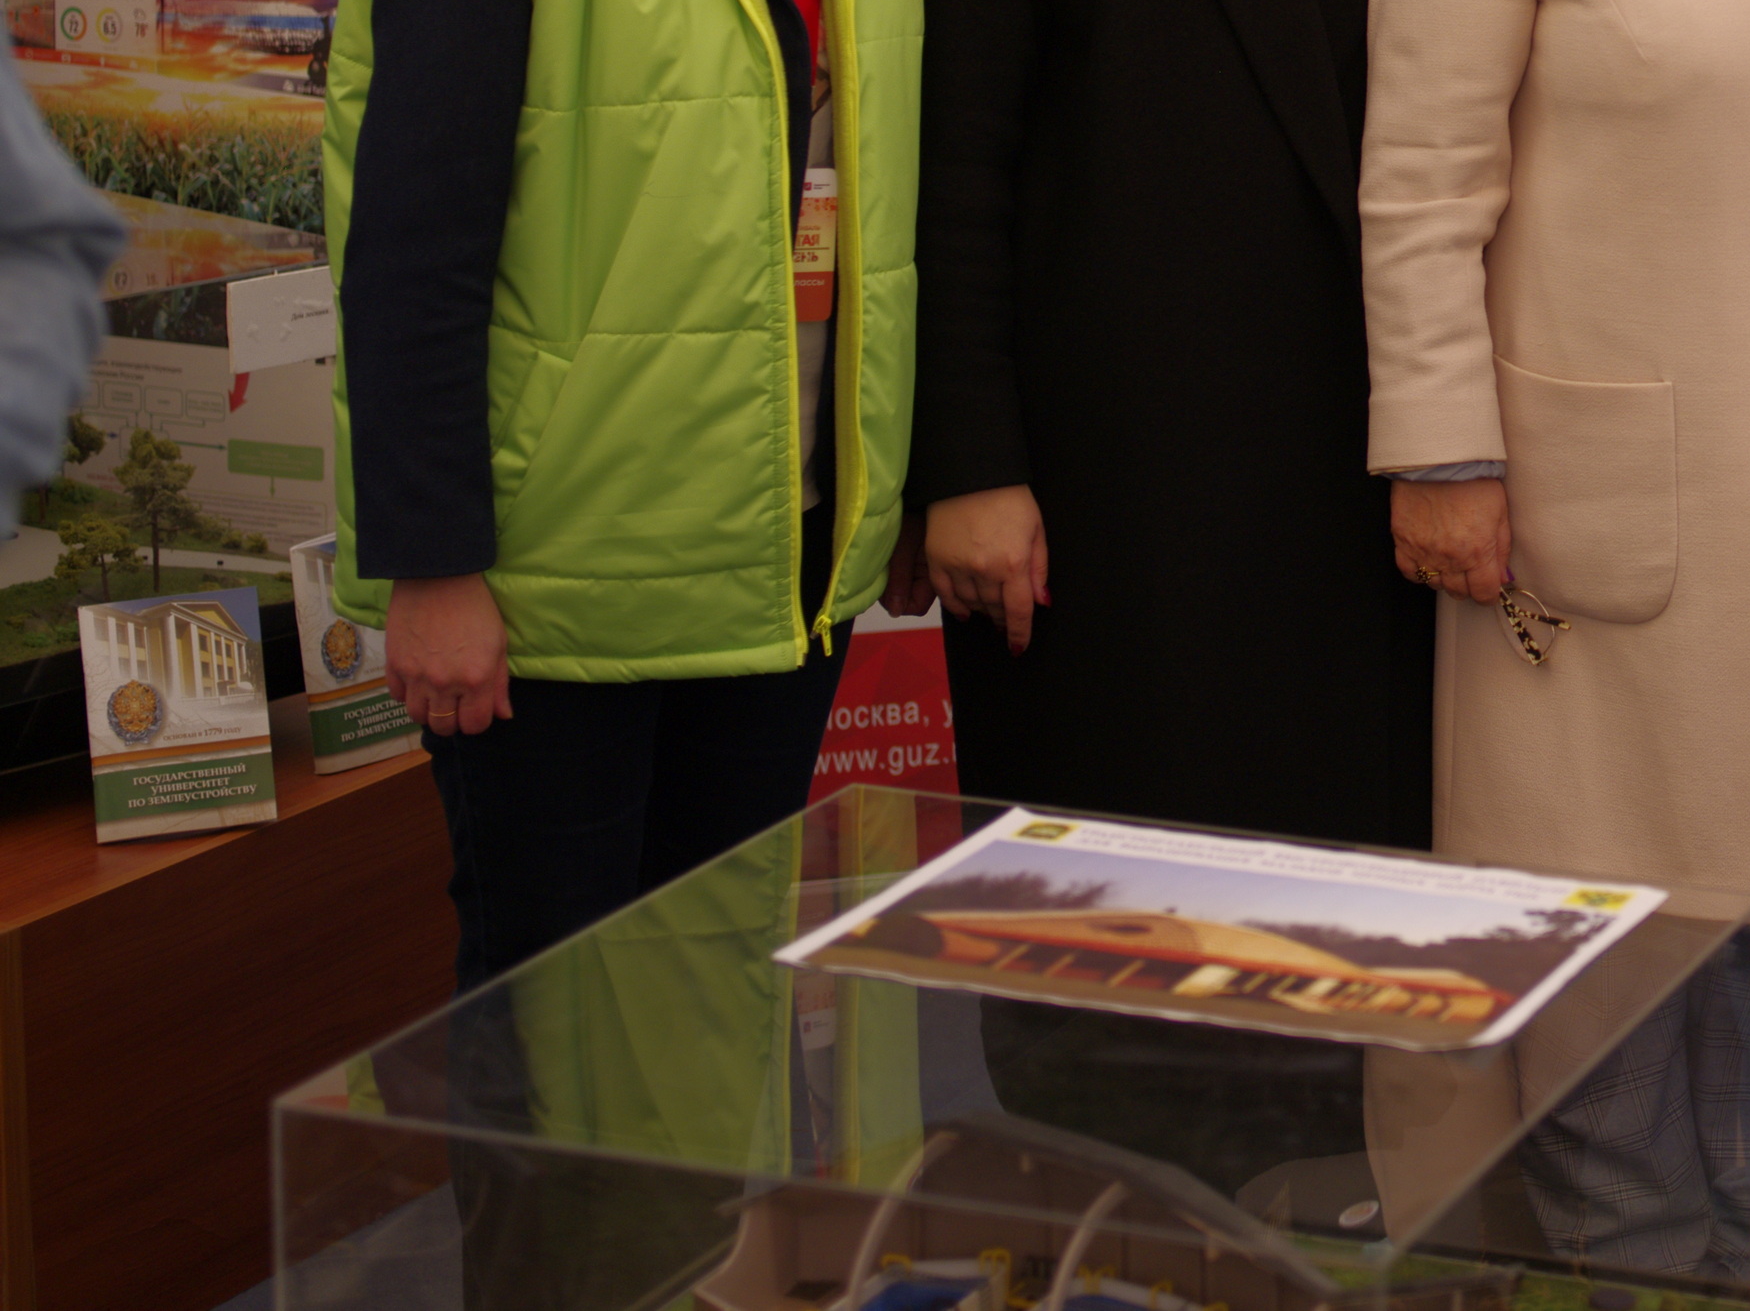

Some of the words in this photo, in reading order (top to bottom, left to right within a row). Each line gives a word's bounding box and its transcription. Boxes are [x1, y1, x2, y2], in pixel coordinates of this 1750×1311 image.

[827, 700, 930, 731] осква,
[132, 762, 247, 787] ГОСУДАРСТВЕННЫЙ
[150, 776, 231, 796] УНИВЕРСИТЕТ
[127, 797, 146, 809] ПО
[147, 783, 258, 807] ЗЕМЛЕУСТРОЙСТВУ
